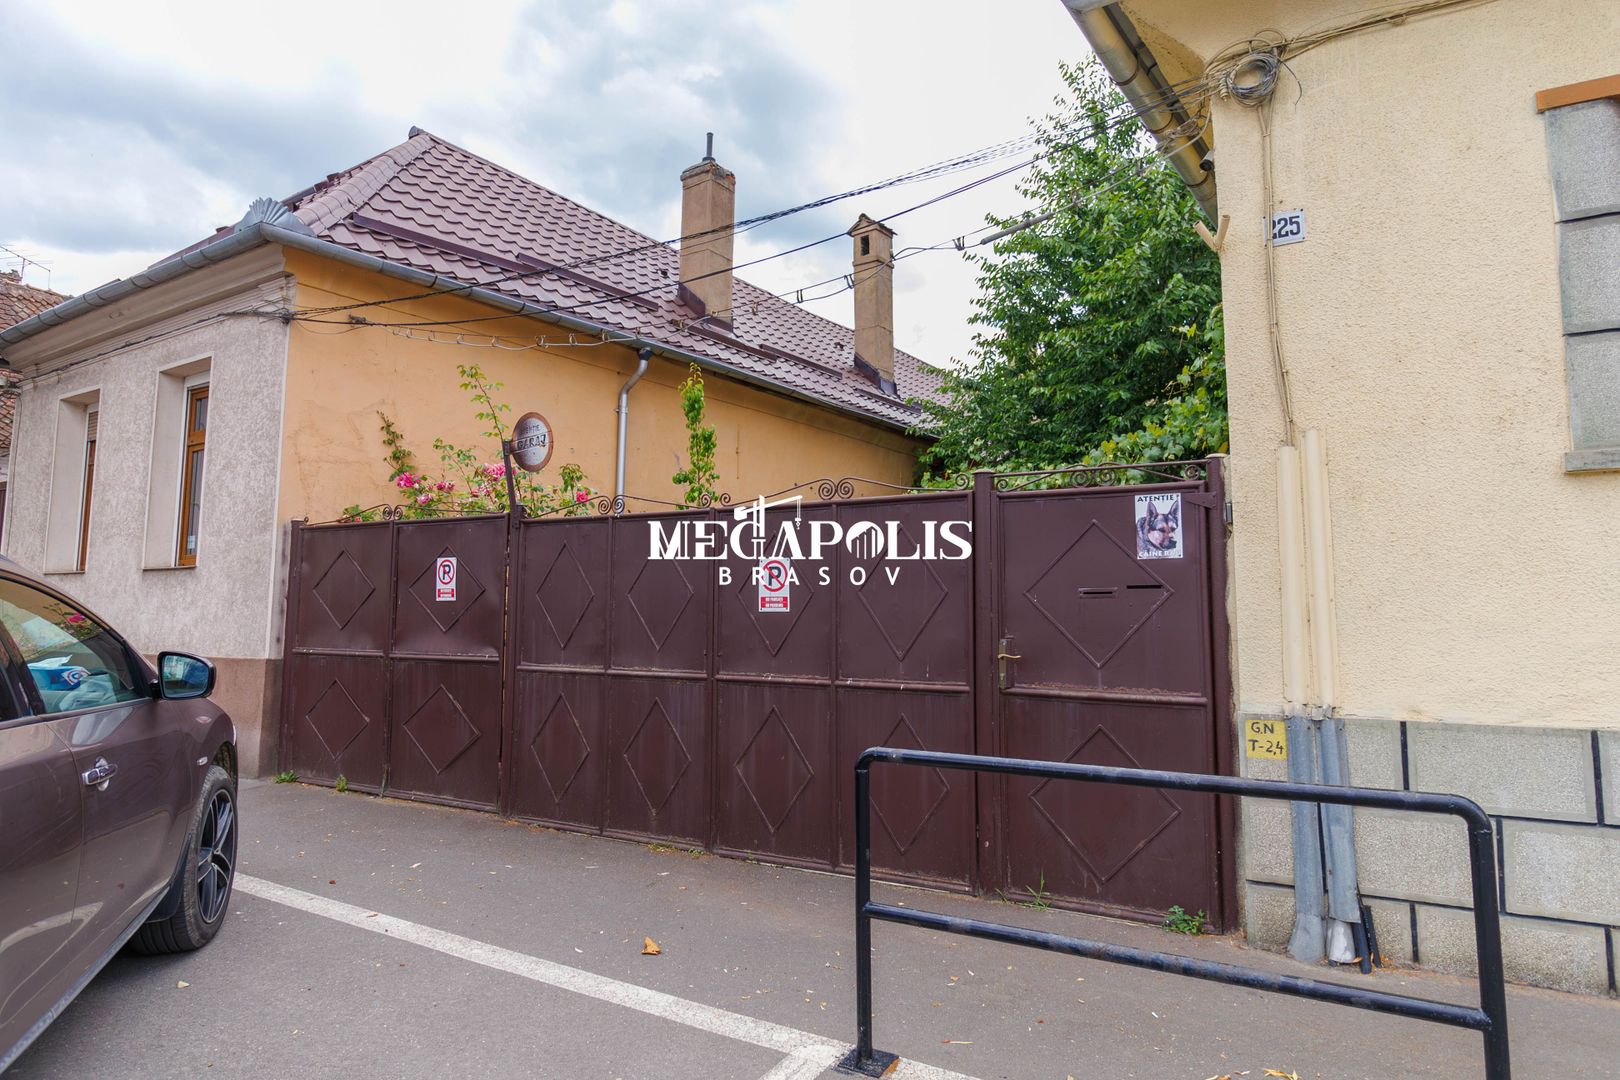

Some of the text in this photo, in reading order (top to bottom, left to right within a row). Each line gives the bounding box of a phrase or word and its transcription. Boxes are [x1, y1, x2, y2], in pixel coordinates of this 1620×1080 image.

[517, 434, 547, 451] GARAJ
[443, 564, 451, 580] P
[768, 566, 782, 587] P
